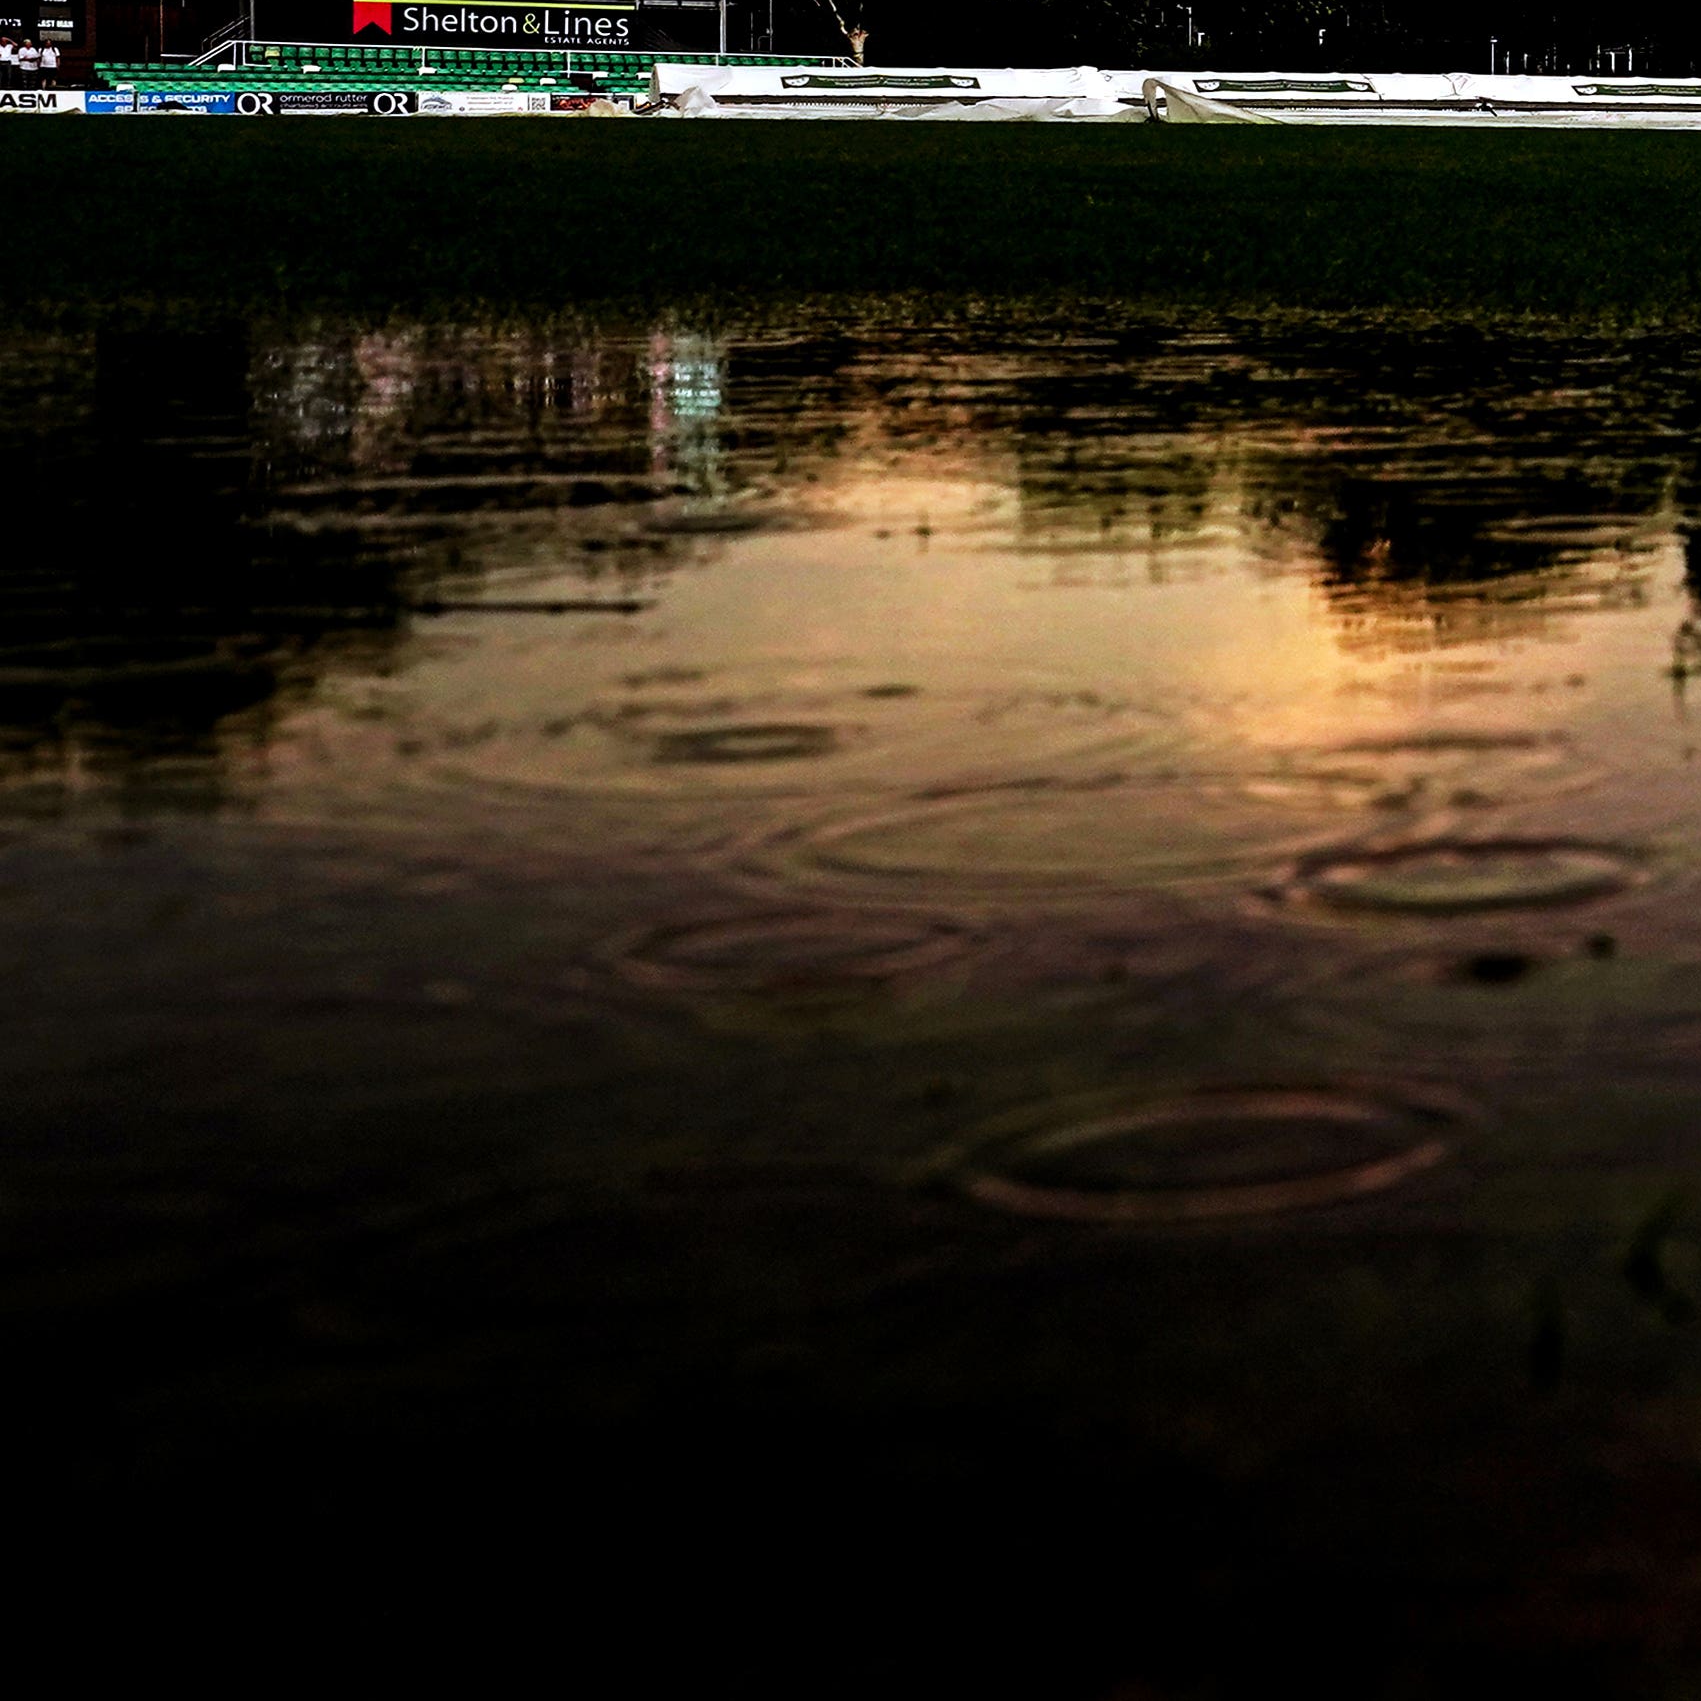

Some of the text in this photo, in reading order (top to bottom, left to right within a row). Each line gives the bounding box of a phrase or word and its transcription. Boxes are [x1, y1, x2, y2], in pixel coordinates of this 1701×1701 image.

[545, 36, 630, 46] ESTATE AGENTS
[280, 94, 368, 103] ormerod rutter
